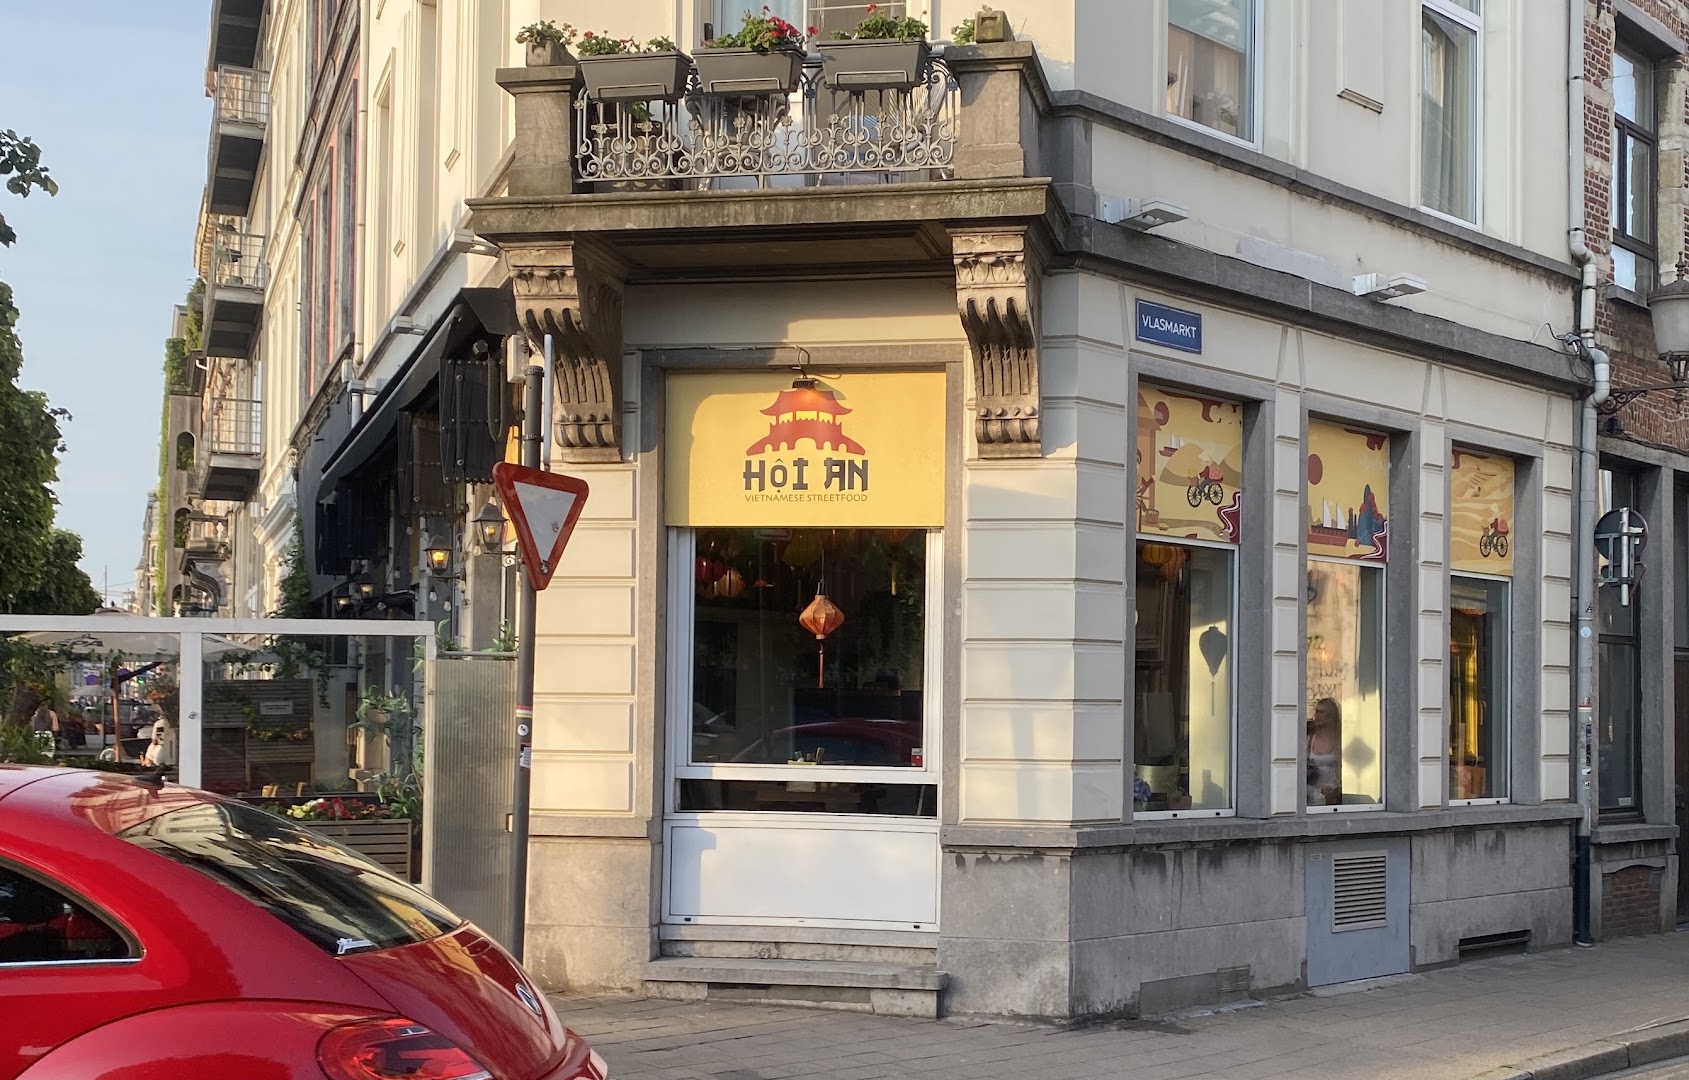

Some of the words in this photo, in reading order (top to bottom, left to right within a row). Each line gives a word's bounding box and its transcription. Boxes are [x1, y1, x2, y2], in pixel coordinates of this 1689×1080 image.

[1141, 314, 1197, 338] VLASMARKT
[824, 457, 869, 492] AN
[745, 494, 804, 502] VIETNAMESE
[807, 494, 868, 502] STREETFOOD
